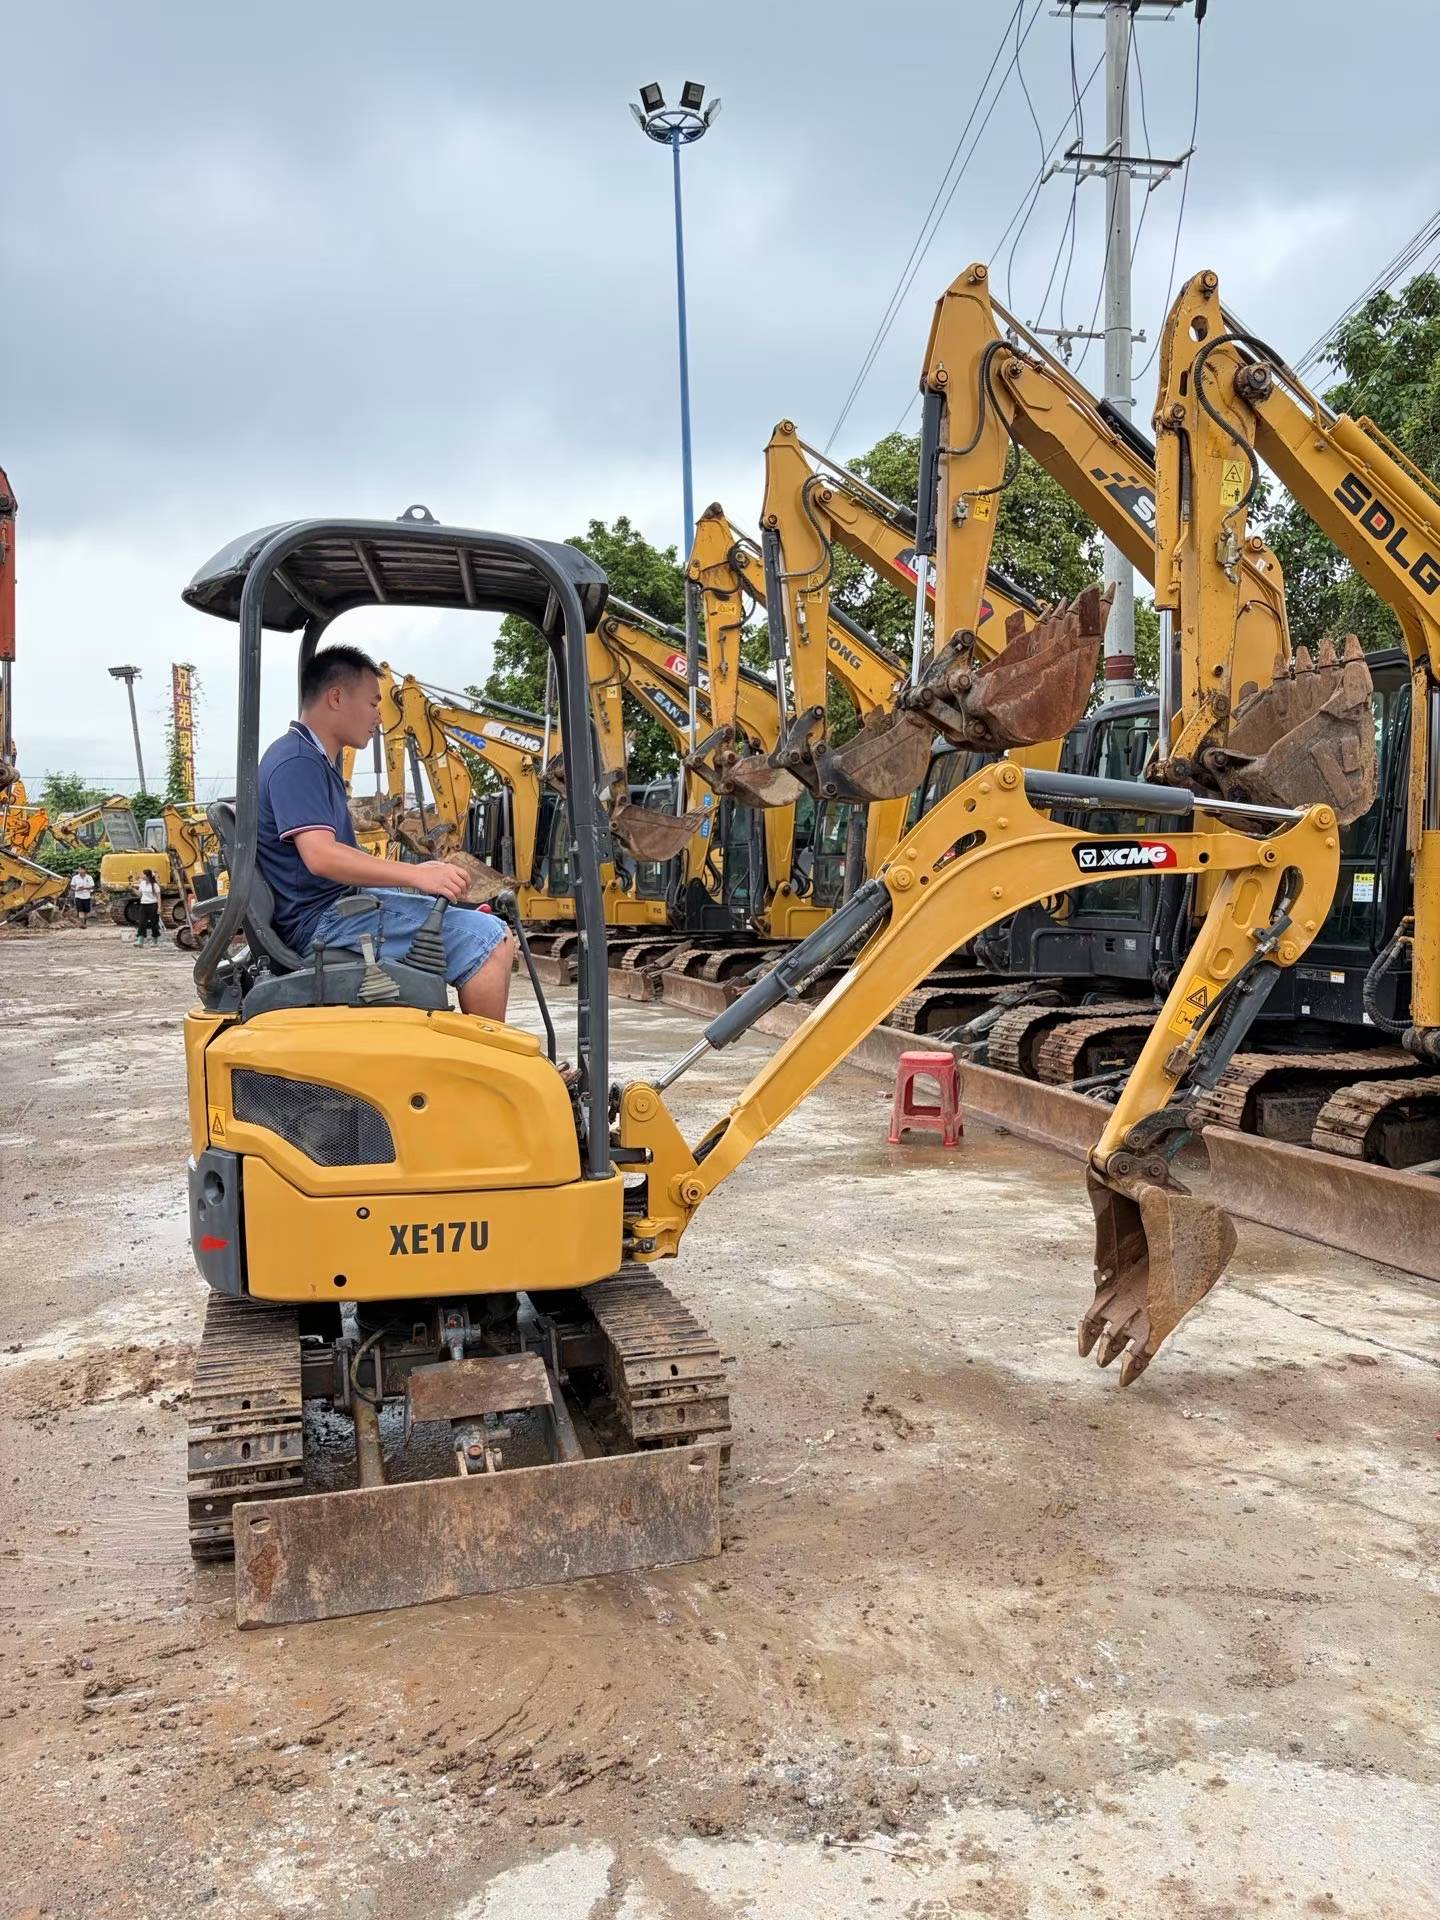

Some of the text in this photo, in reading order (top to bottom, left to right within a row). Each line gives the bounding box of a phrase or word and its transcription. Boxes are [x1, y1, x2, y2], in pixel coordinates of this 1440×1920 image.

[1334, 472, 1440, 595] SDLG
[654, 691, 684, 725] SAN
[501, 728, 541, 752] XCMG
[1097, 846, 1167, 867] XCMG
[389, 1221, 489, 1255] XE17U
